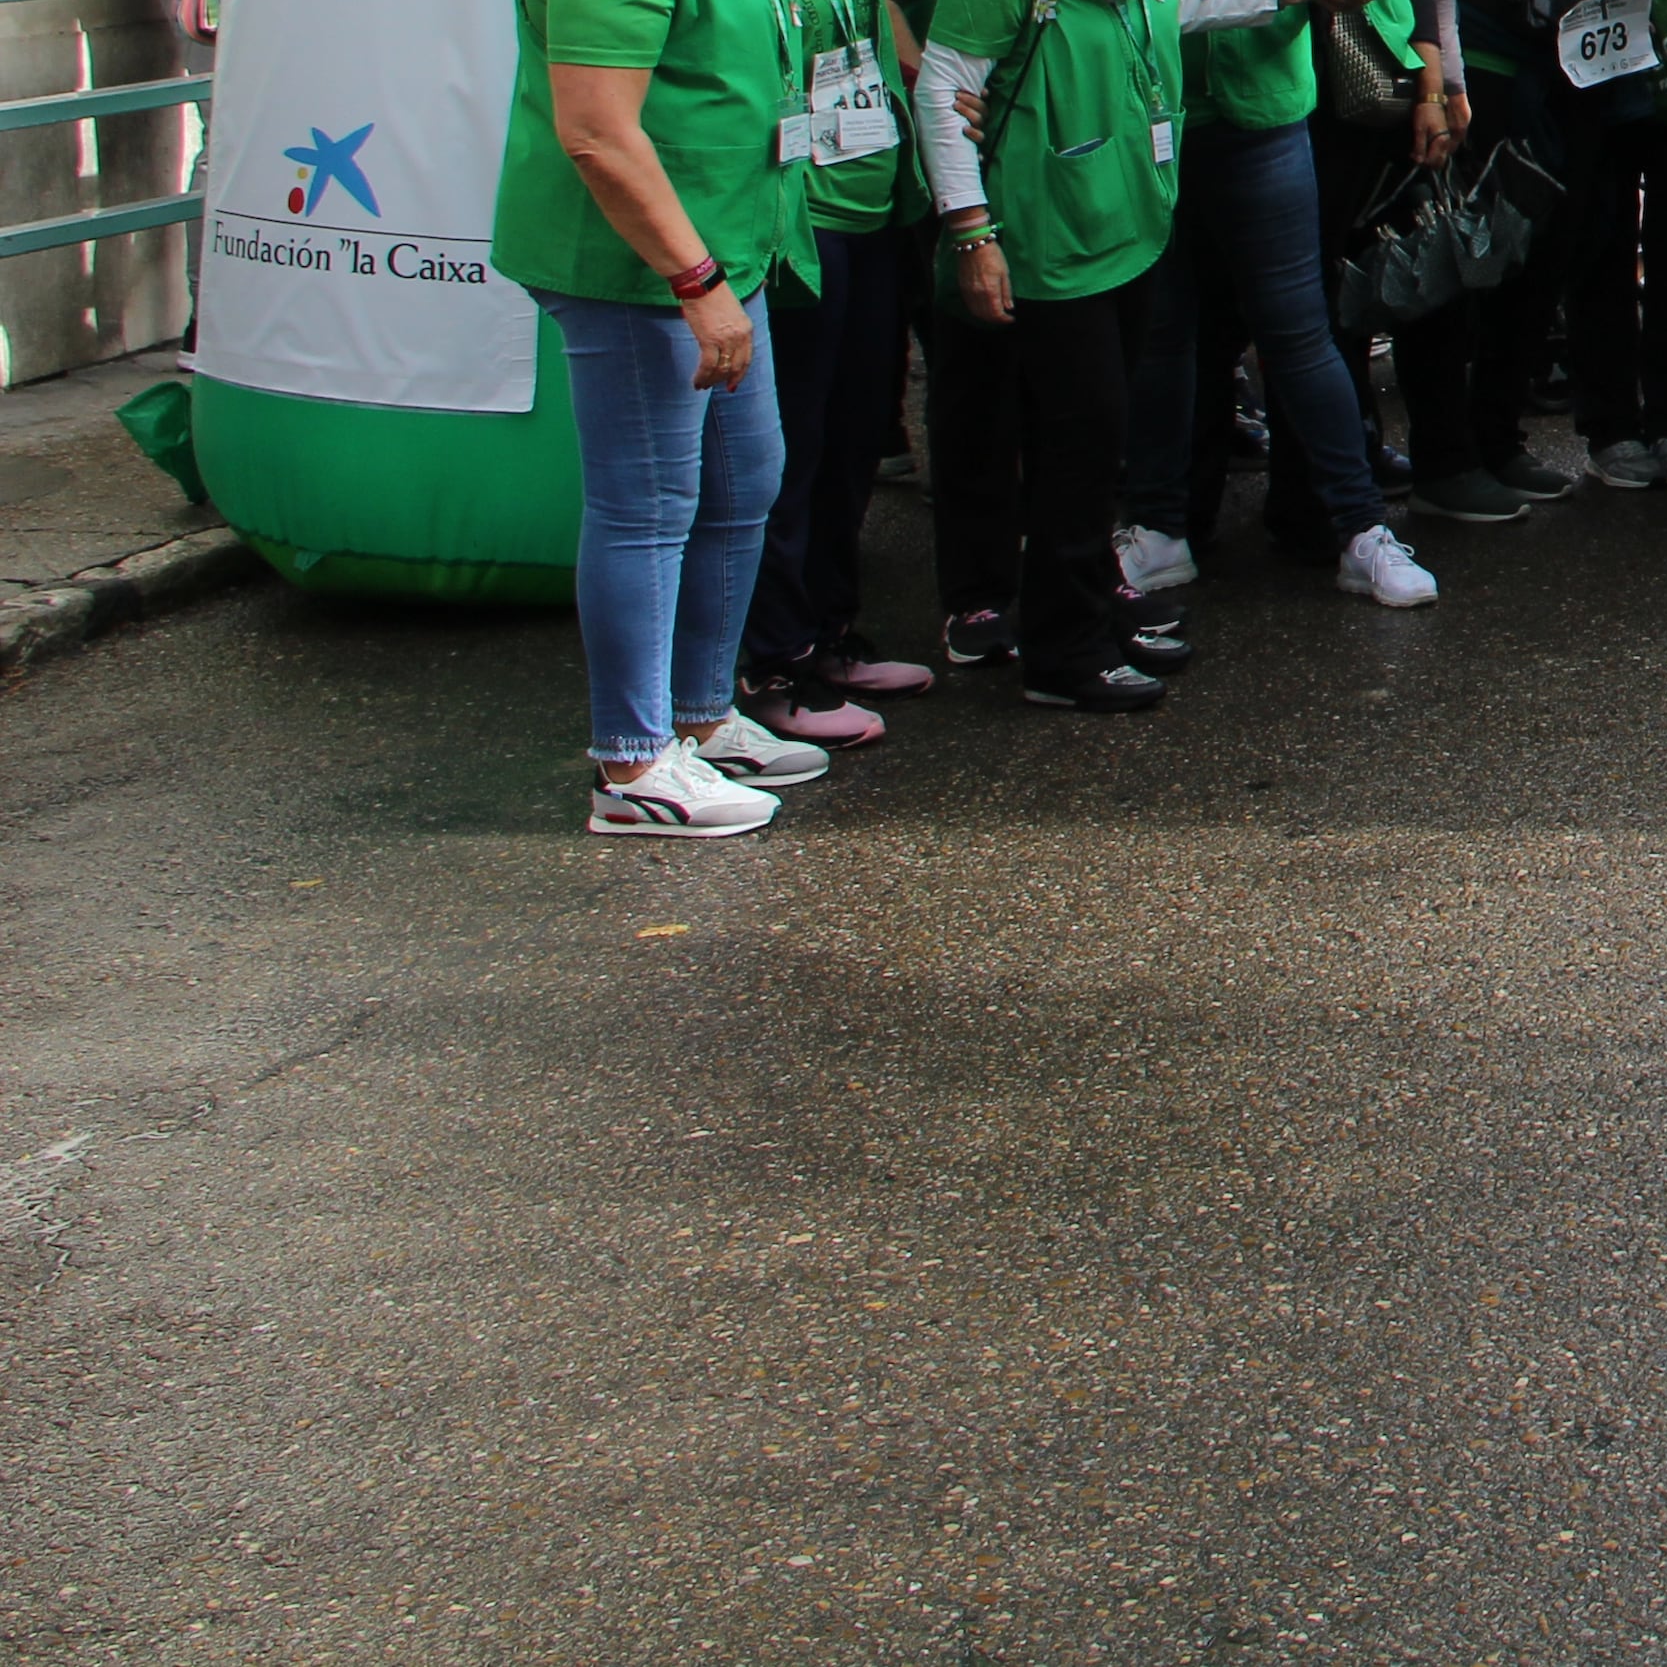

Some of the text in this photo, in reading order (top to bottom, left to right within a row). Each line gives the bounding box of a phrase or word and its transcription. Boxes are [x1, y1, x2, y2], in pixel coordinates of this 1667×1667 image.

[1581, 22, 1627, 61] 673
[213, 220, 332, 272] Fundación
[386, 242, 487, 285] Caixa
